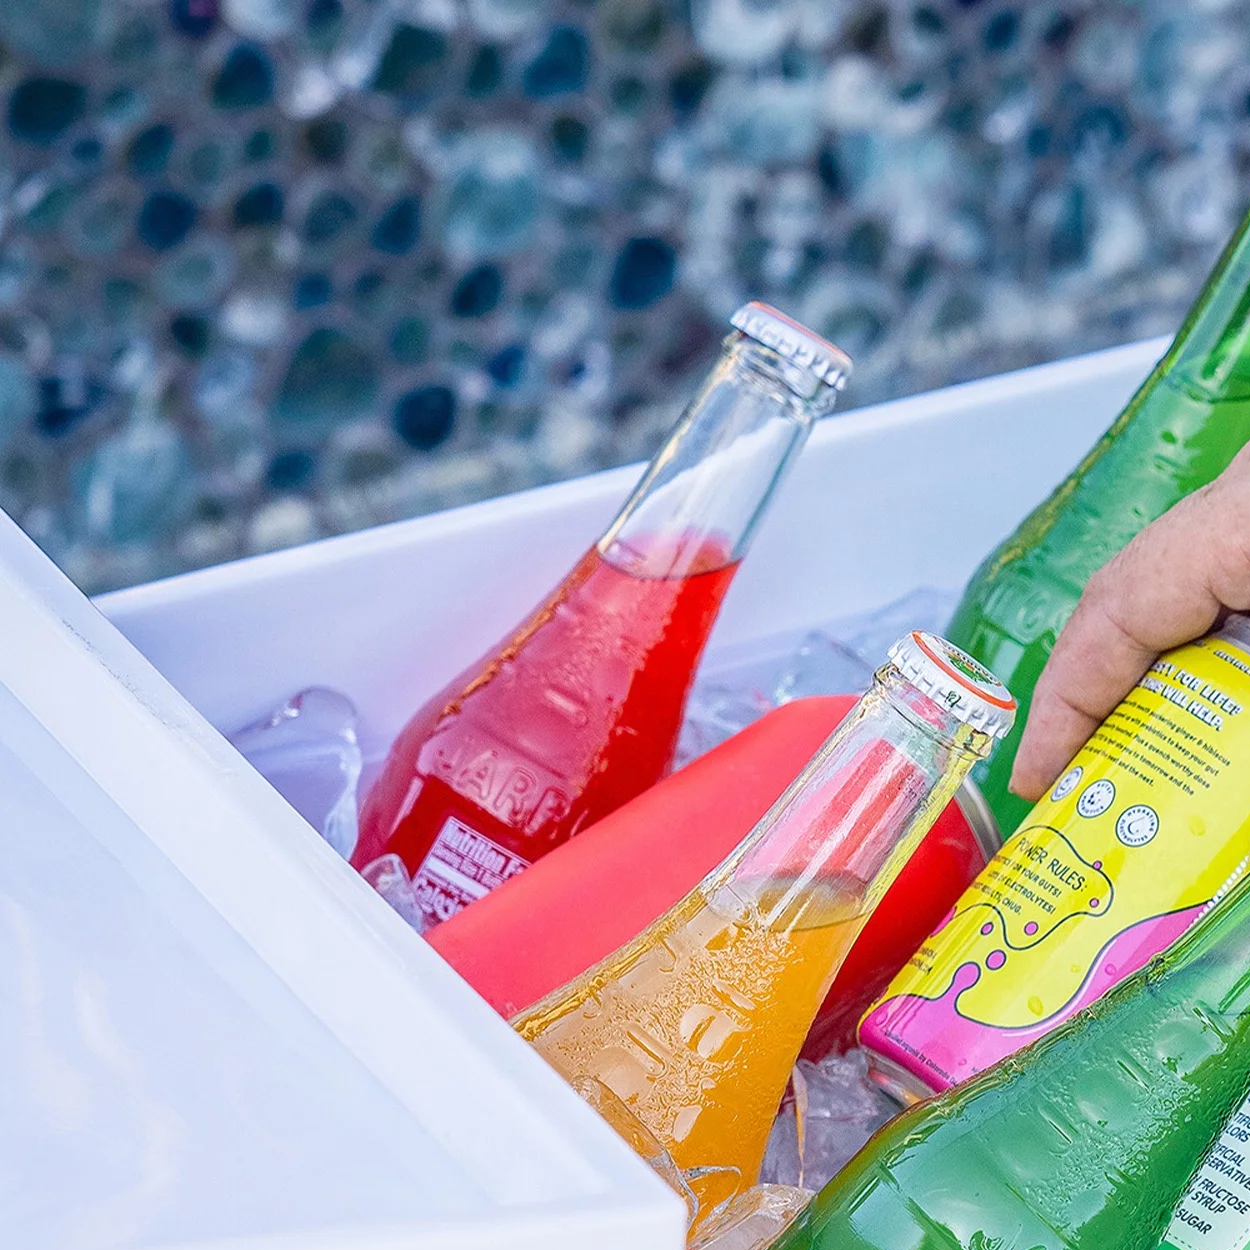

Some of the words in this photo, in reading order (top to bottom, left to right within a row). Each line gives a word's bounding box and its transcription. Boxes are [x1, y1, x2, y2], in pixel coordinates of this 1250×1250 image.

[1161, 685, 1190, 708] WILL
[1174, 669, 1202, 691] FOR
[1166, 737, 1175, 746] to
[1172, 742, 1191, 757] keep
[1188, 752, 1206, 767] your
[1204, 763, 1219, 777] gut
[1174, 725, 1198, 744] ginger
[1200, 743, 1232, 767] hibiscus
[1127, 765, 1139, 776] the
[1137, 754, 1170, 779] tomorrow
[1167, 773, 1183, 787] and
[1180, 783, 1195, 796] the
[1146, 743, 1171, 762] quench
[1167, 757, 1194, 778] worthy
[1191, 773, 1211, 789] dose
[1020, 867, 1039, 883] YOUR
[1036, 877, 1062, 898] GUTS!
[1044, 856, 1091, 894] RULES:
[1000, 895, 1024, 915] CHUG.
[1002, 877, 1057, 915] ELECTROLYTES!
[1190, 1191, 1227, 1214] SYRUP
[1198, 1178, 1250, 1215] FRUCTOSE
[1175, 1208, 1212, 1235] SUGAR
